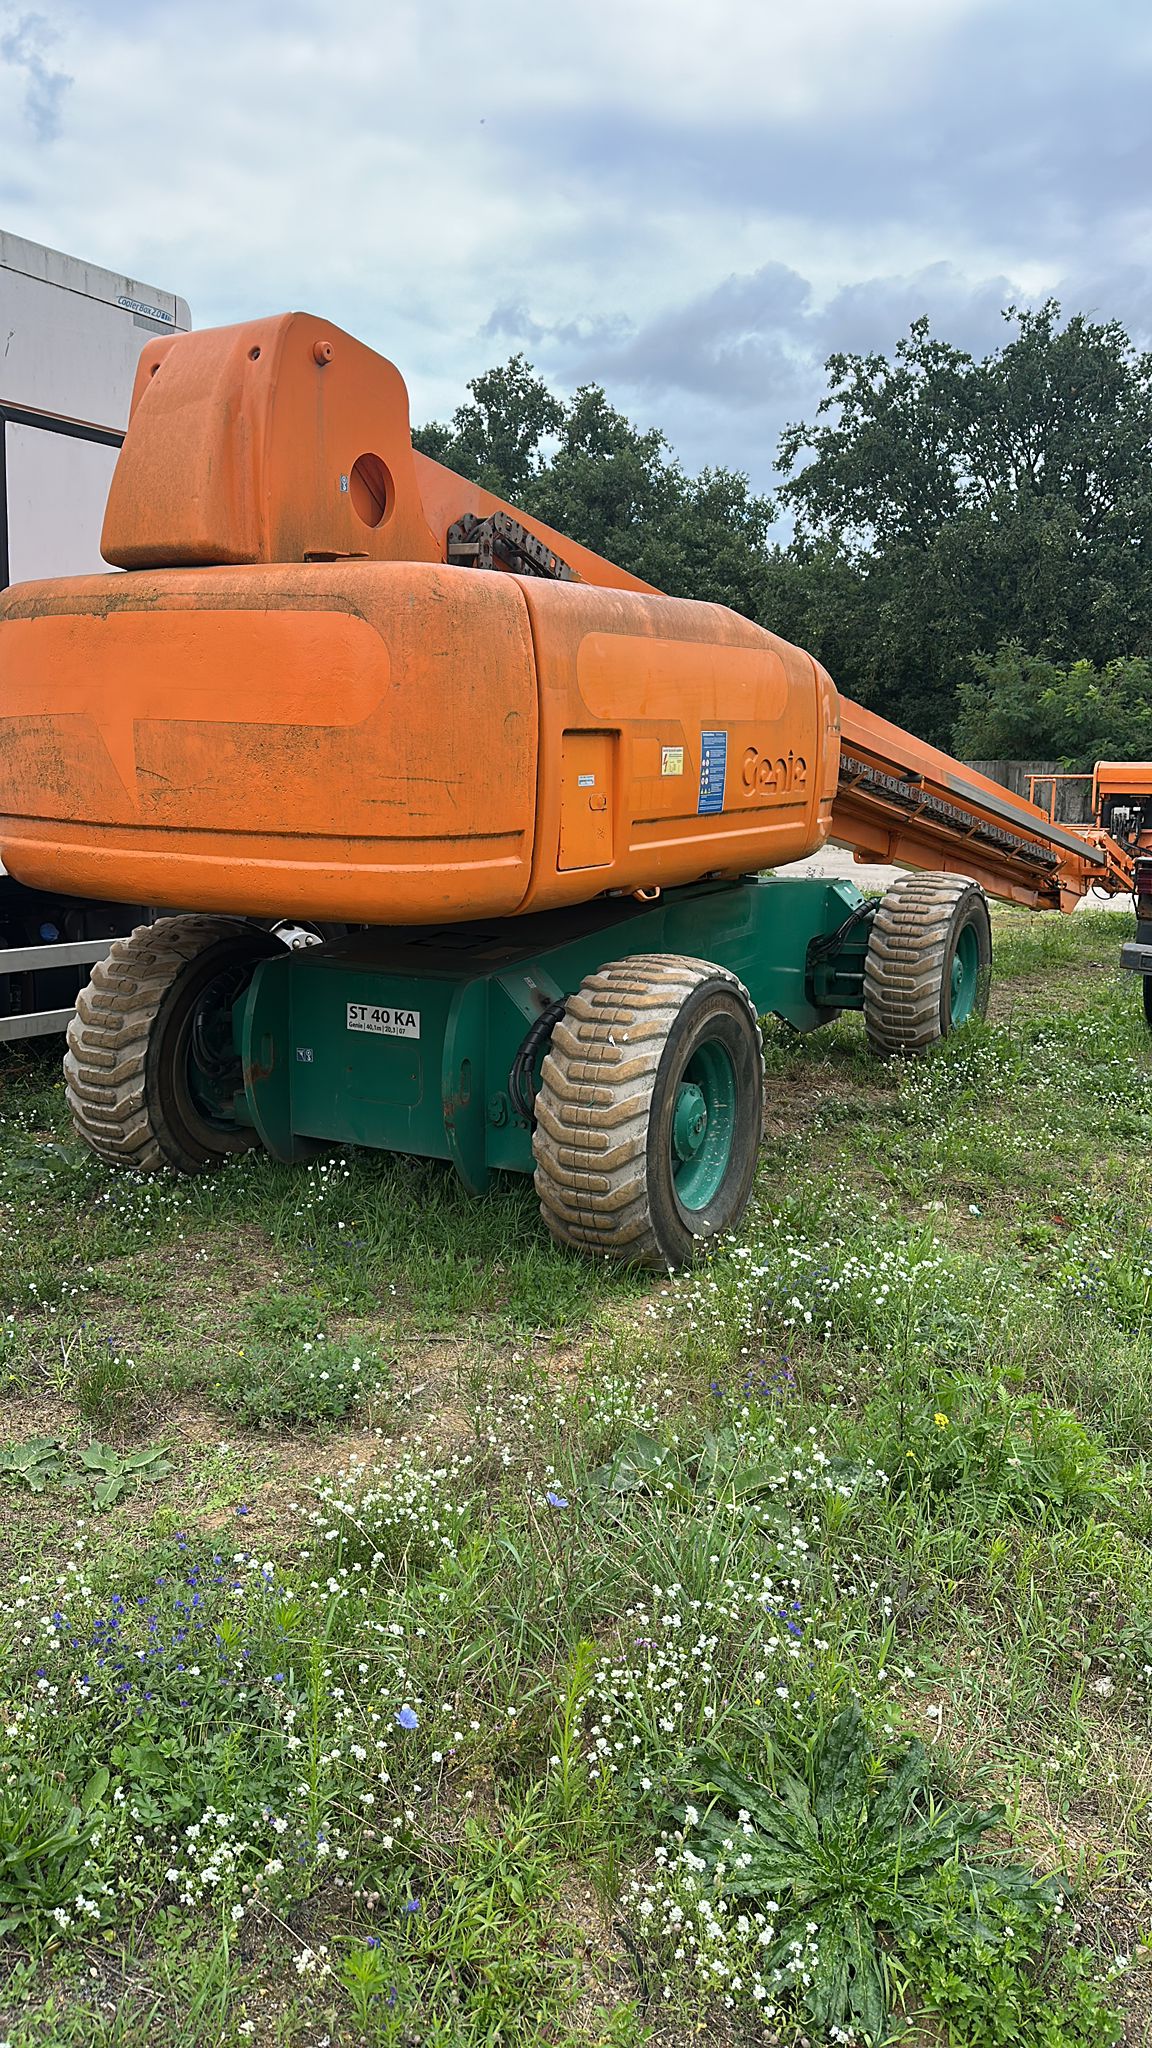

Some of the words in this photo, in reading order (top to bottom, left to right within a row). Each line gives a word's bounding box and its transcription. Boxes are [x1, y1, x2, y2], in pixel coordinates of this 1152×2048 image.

[151, 309, 161, 318] 2.0
[742, 747, 806, 797] Genie
[349, 1005, 367, 1021] ST
[371, 1009, 390, 1024] 40
[394, 1011, 417, 1028] KA
[349, 1021, 363, 1029] Genie
